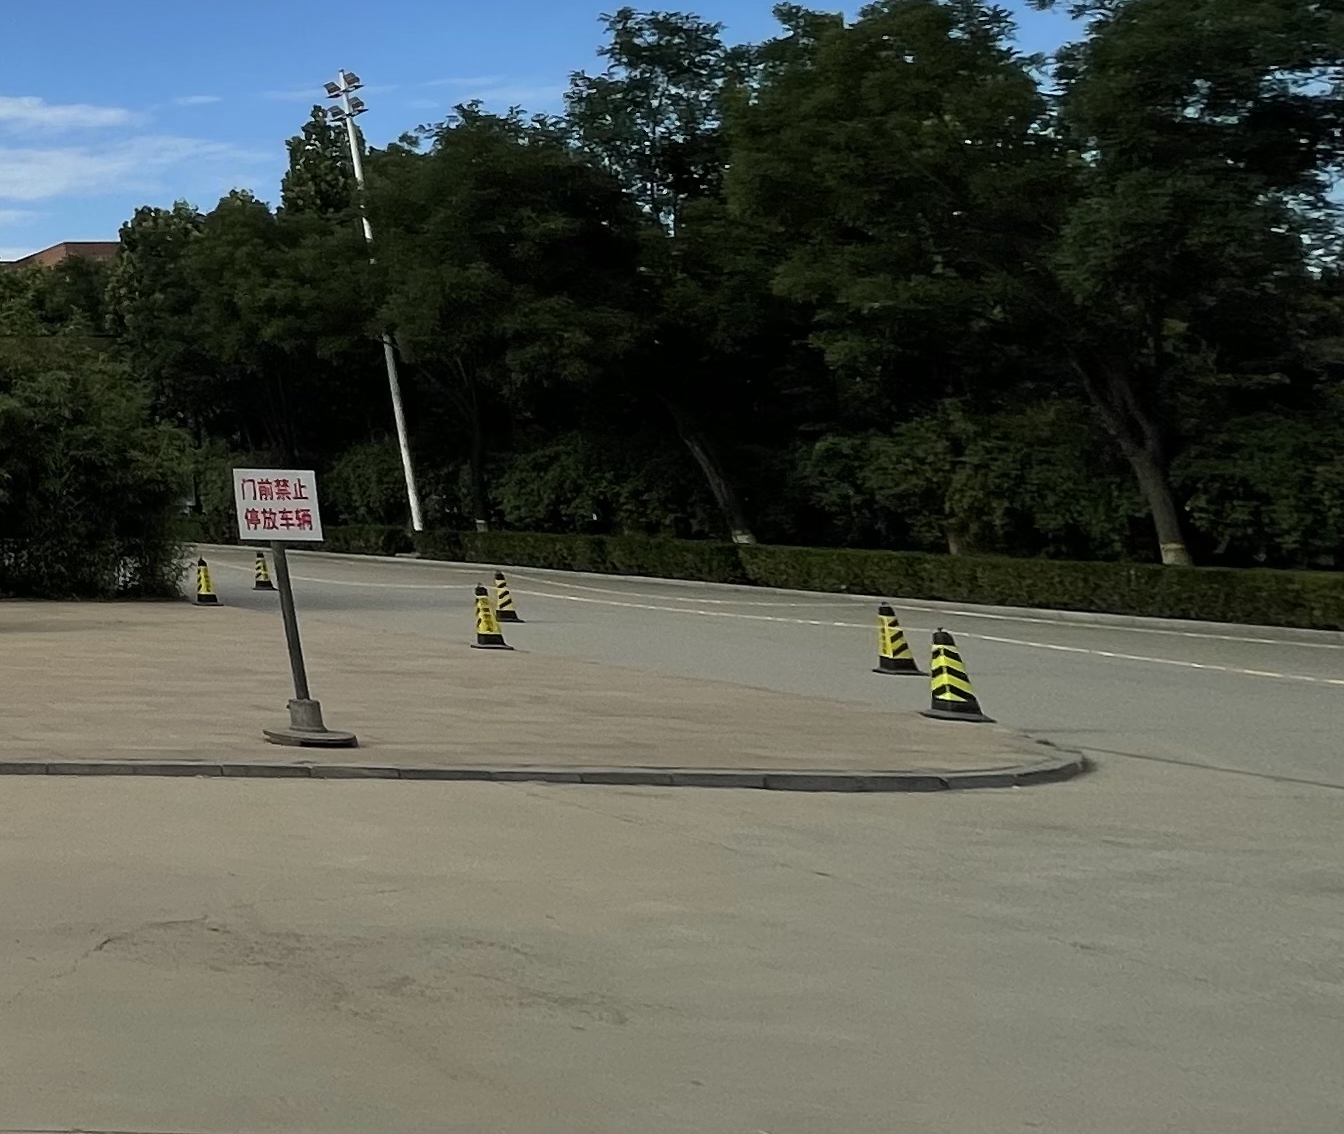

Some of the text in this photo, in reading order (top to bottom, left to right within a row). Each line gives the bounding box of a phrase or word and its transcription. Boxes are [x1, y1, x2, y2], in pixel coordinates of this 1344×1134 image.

[240, 477, 309, 501] 门前禁止
[244, 507, 313, 531] 停放车辆
